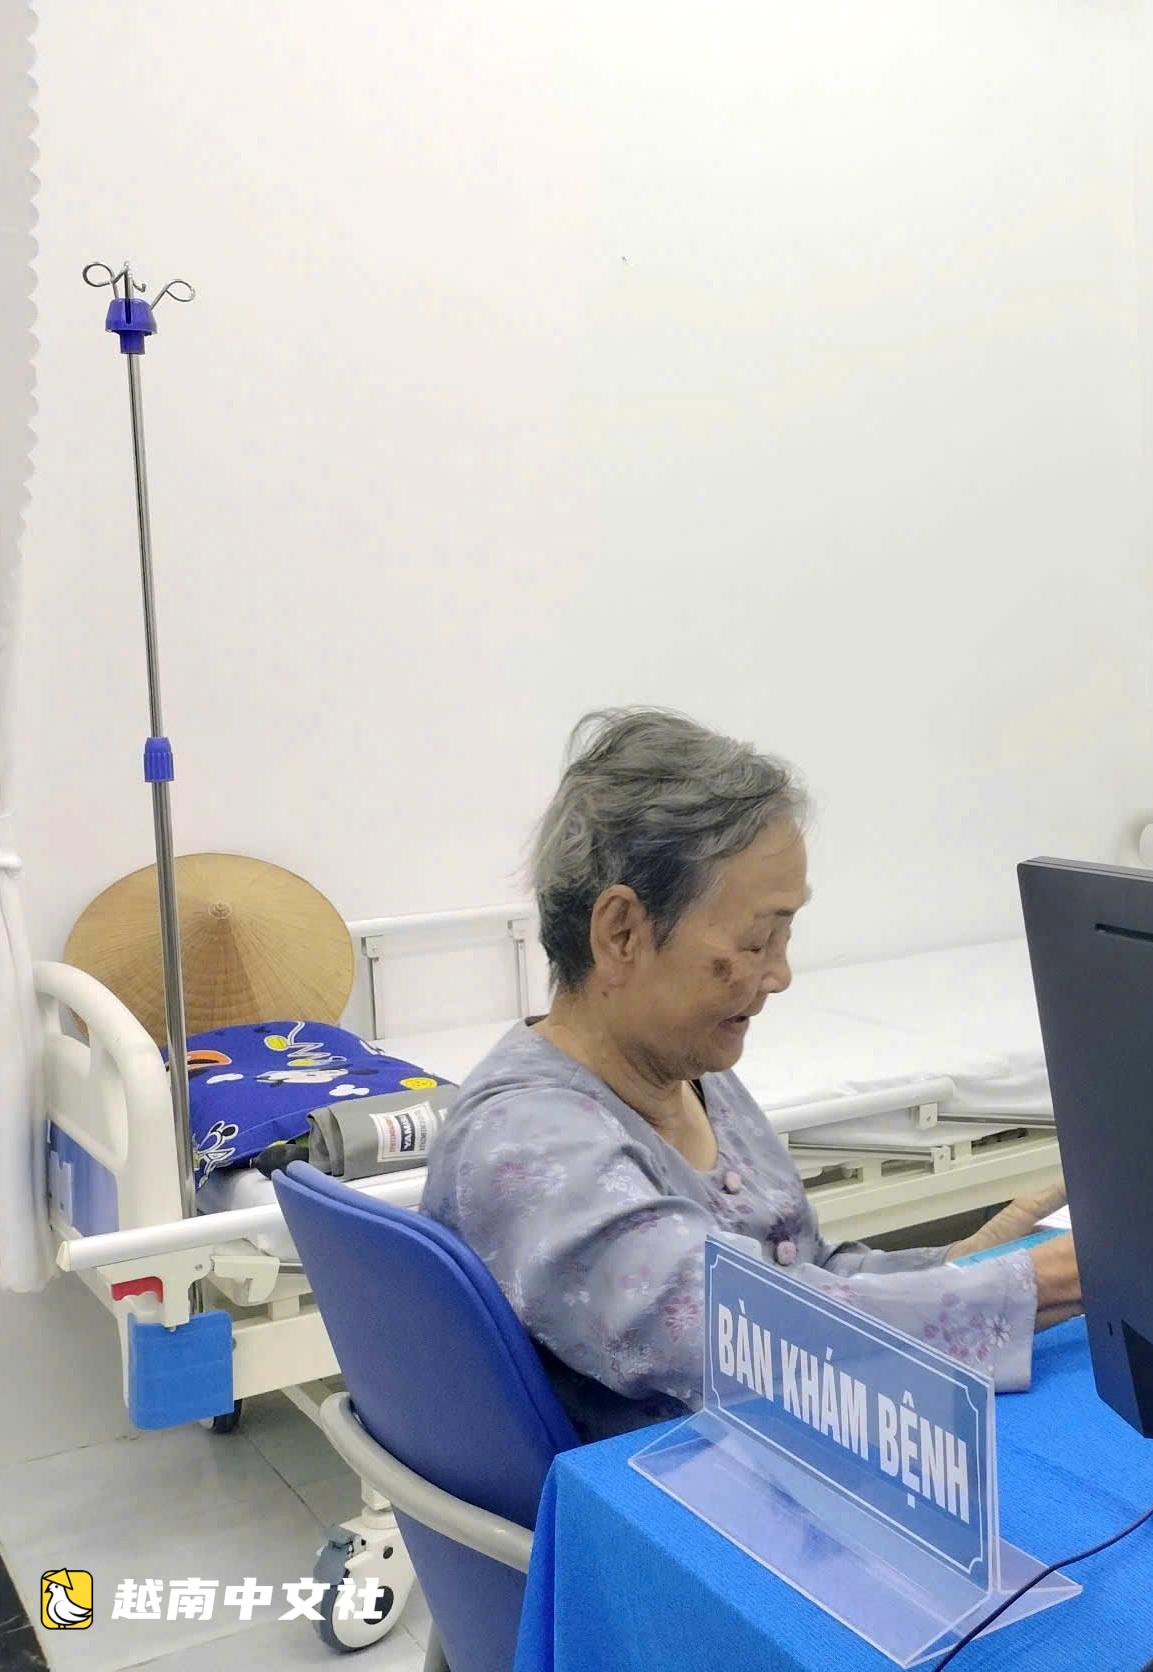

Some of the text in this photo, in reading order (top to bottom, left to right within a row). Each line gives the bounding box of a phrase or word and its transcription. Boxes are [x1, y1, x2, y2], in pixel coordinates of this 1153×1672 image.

[718, 1300, 970, 1524] BÀN KHÁM BỆNH
